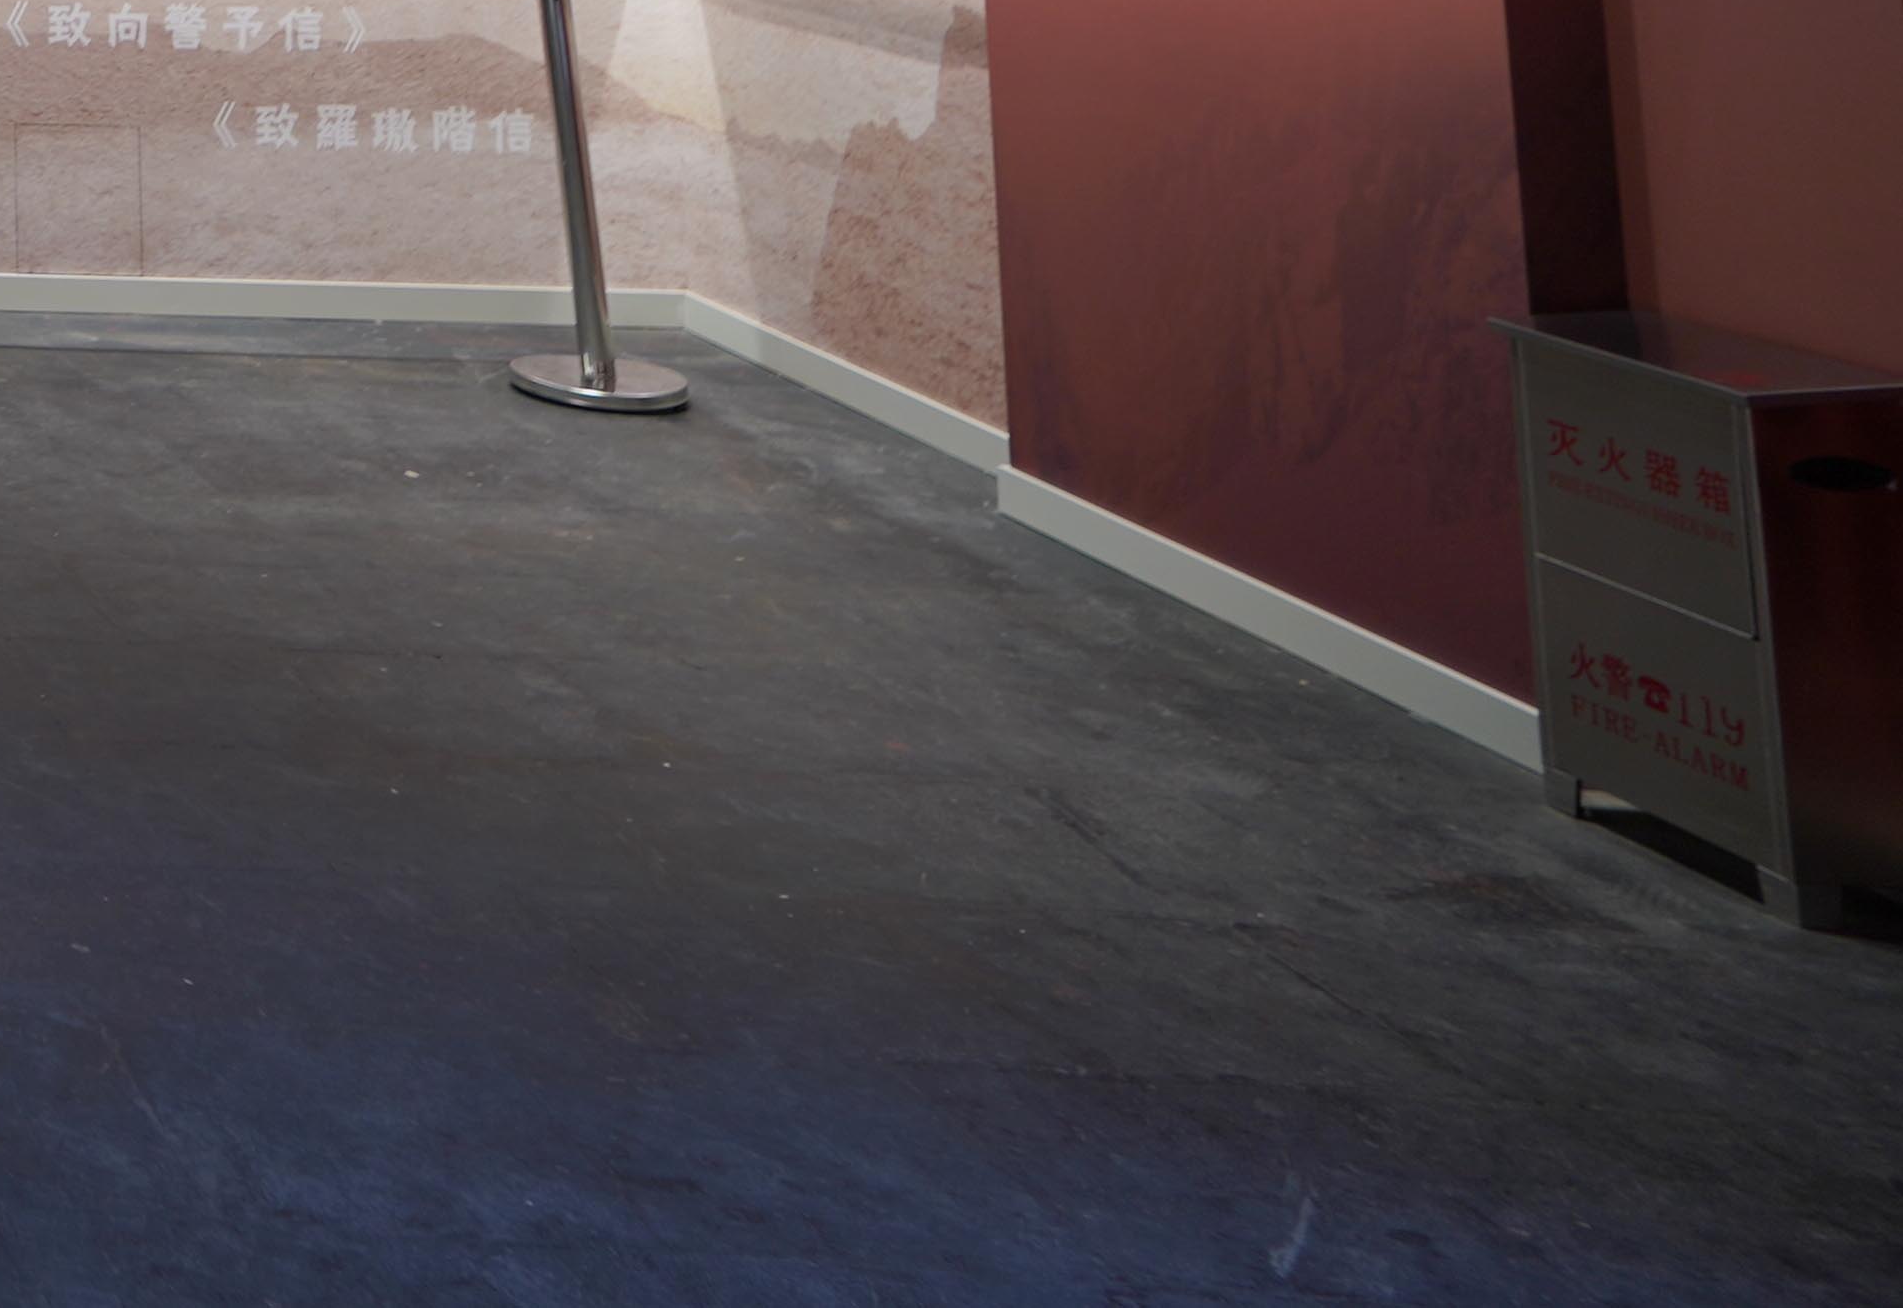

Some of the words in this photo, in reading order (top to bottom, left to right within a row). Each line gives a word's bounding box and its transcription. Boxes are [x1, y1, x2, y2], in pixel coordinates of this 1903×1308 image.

[5, 0, 367, 54] 《致向警予信》
[1546, 417, 1733, 515] 灭火器箱
[1569, 641, 1632, 702] 火警
